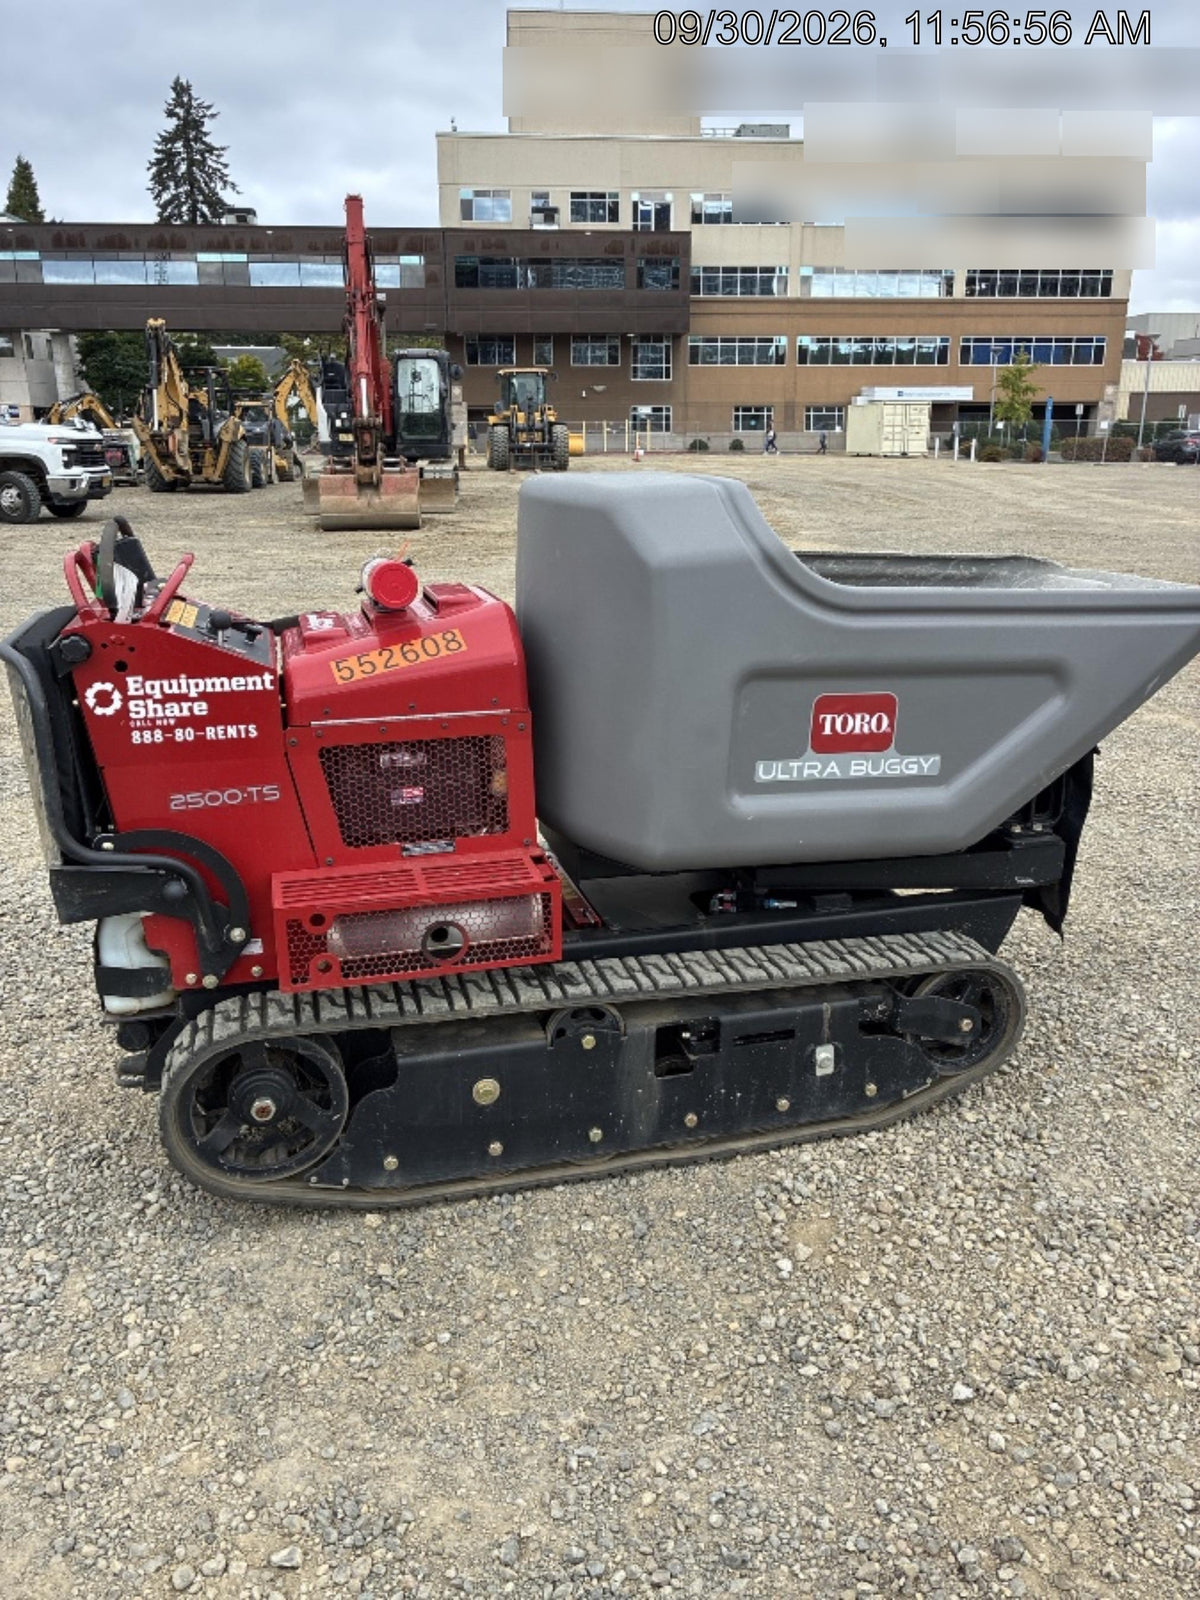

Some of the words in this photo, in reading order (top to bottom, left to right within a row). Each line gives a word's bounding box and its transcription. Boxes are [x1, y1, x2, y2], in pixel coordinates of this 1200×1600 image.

[335, 630, 464, 682] 552608
[125, 672, 275, 699] Equipment
[128, 699, 209, 719] Share
[131, 724, 258, 745] 888-80-RENTS
[819, 712, 889, 735] TORO
[758, 760, 841, 780] ULTRA
[850, 757, 936, 776] BUGGY
